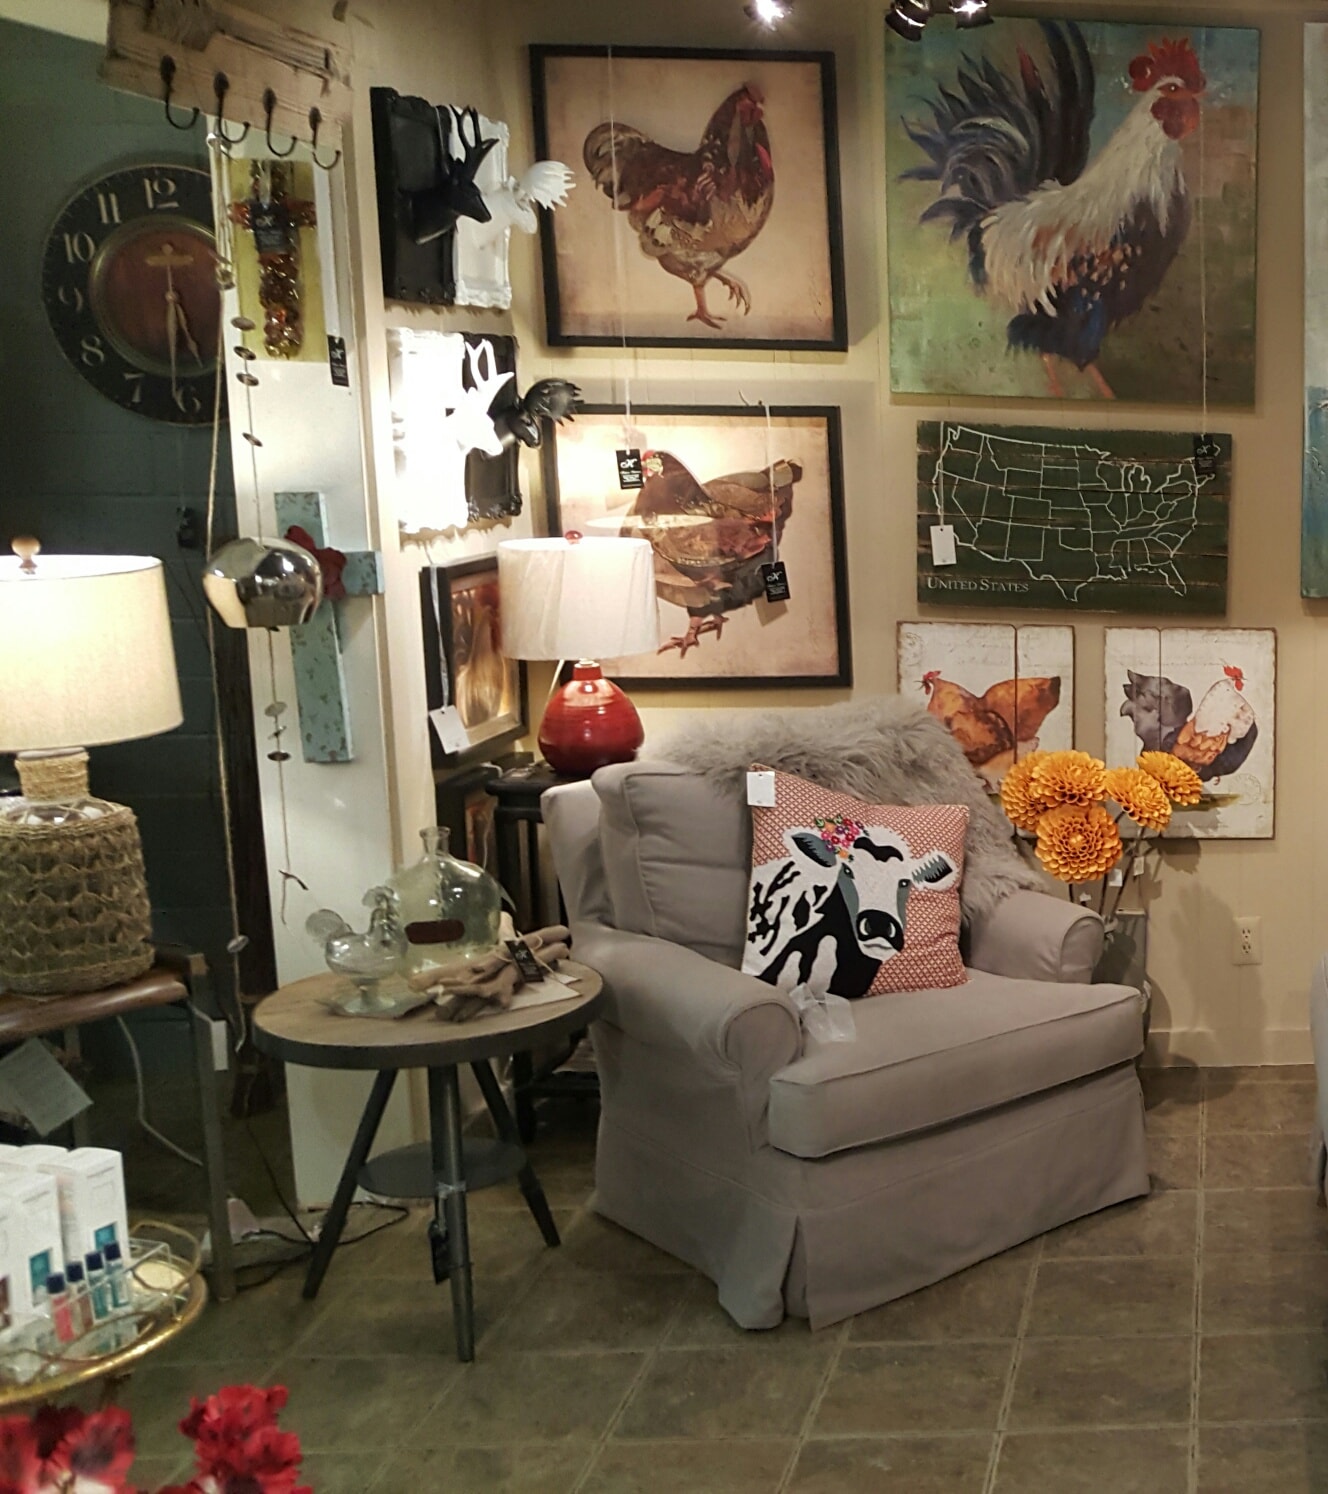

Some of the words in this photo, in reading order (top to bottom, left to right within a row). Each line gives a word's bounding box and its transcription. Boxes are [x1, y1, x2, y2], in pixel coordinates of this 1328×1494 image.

[98, 192, 121, 224] 11
[144, 177, 179, 209] 12
[63, 231, 95, 263] 10
[58, 285, 83, 312] 9
[80, 334, 105, 366] 8
[123, 372, 146, 403] 7
[174, 384, 201, 413] 6
[926, 576, 978, 591] UNITED
[979, 578, 1030, 592] STATES
